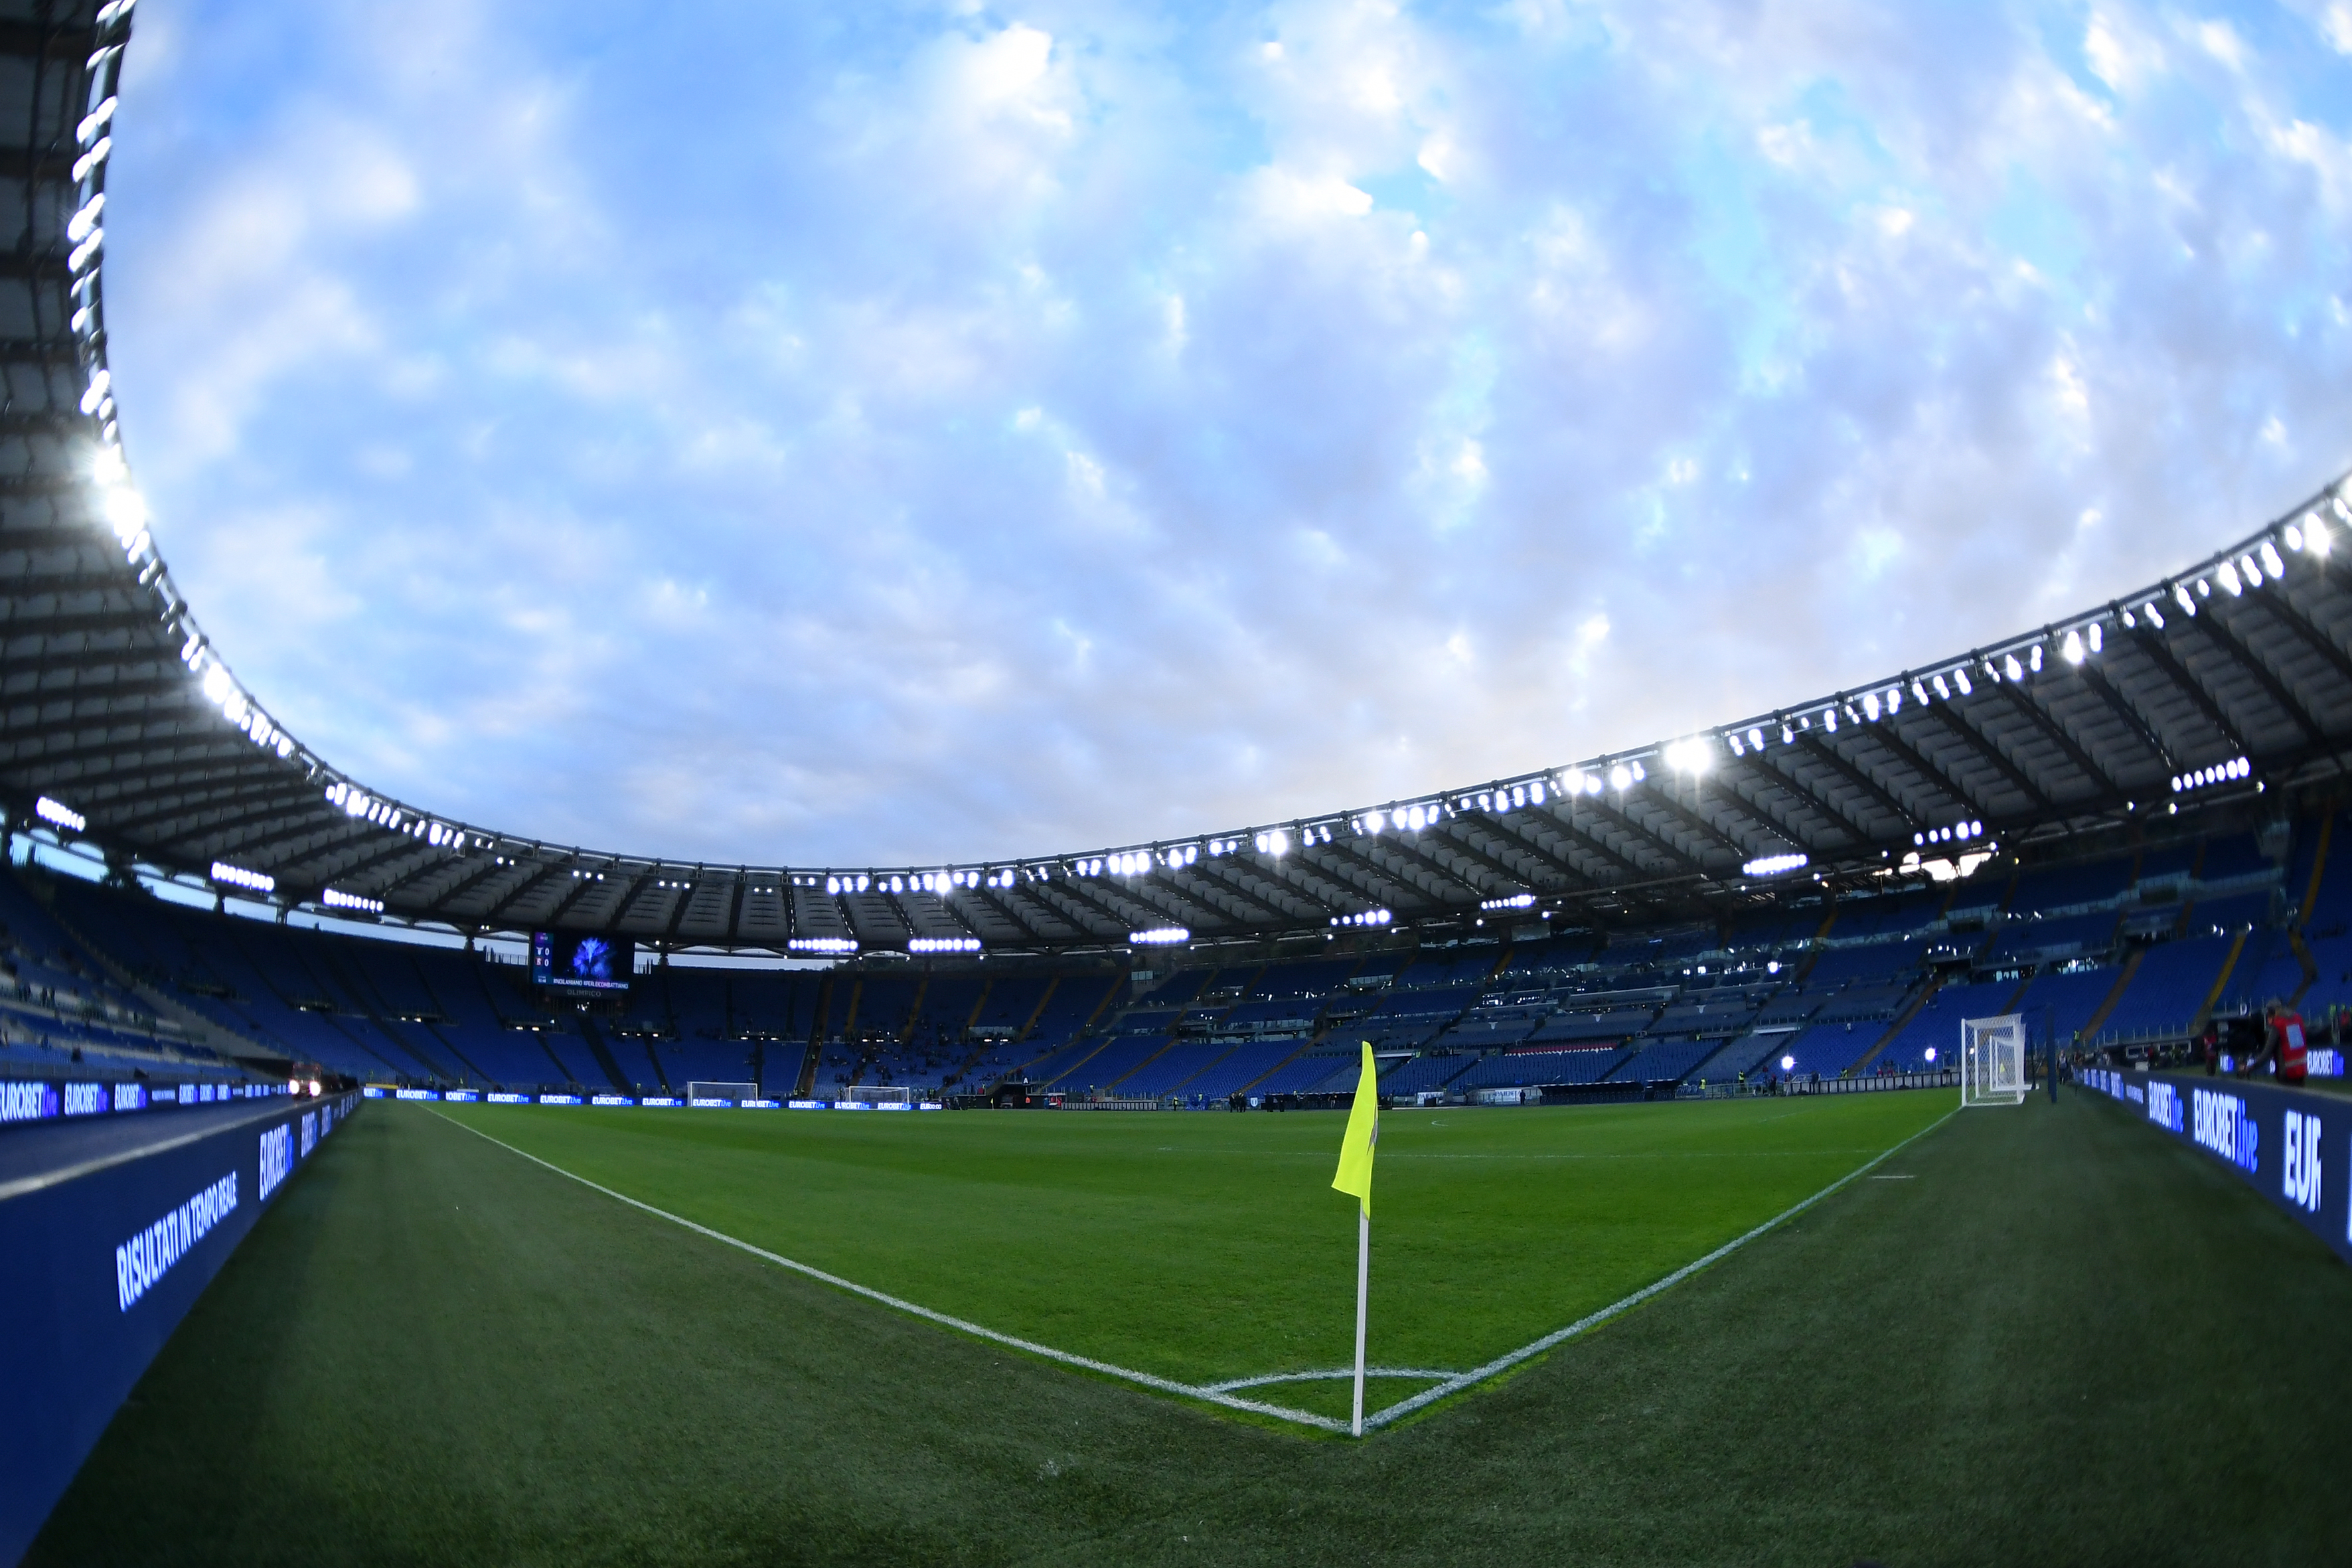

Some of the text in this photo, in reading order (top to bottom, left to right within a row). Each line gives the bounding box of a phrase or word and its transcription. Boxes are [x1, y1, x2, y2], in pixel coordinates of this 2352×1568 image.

[116, 1170, 238, 1312] RISULTATI IN TEMPO REALE
